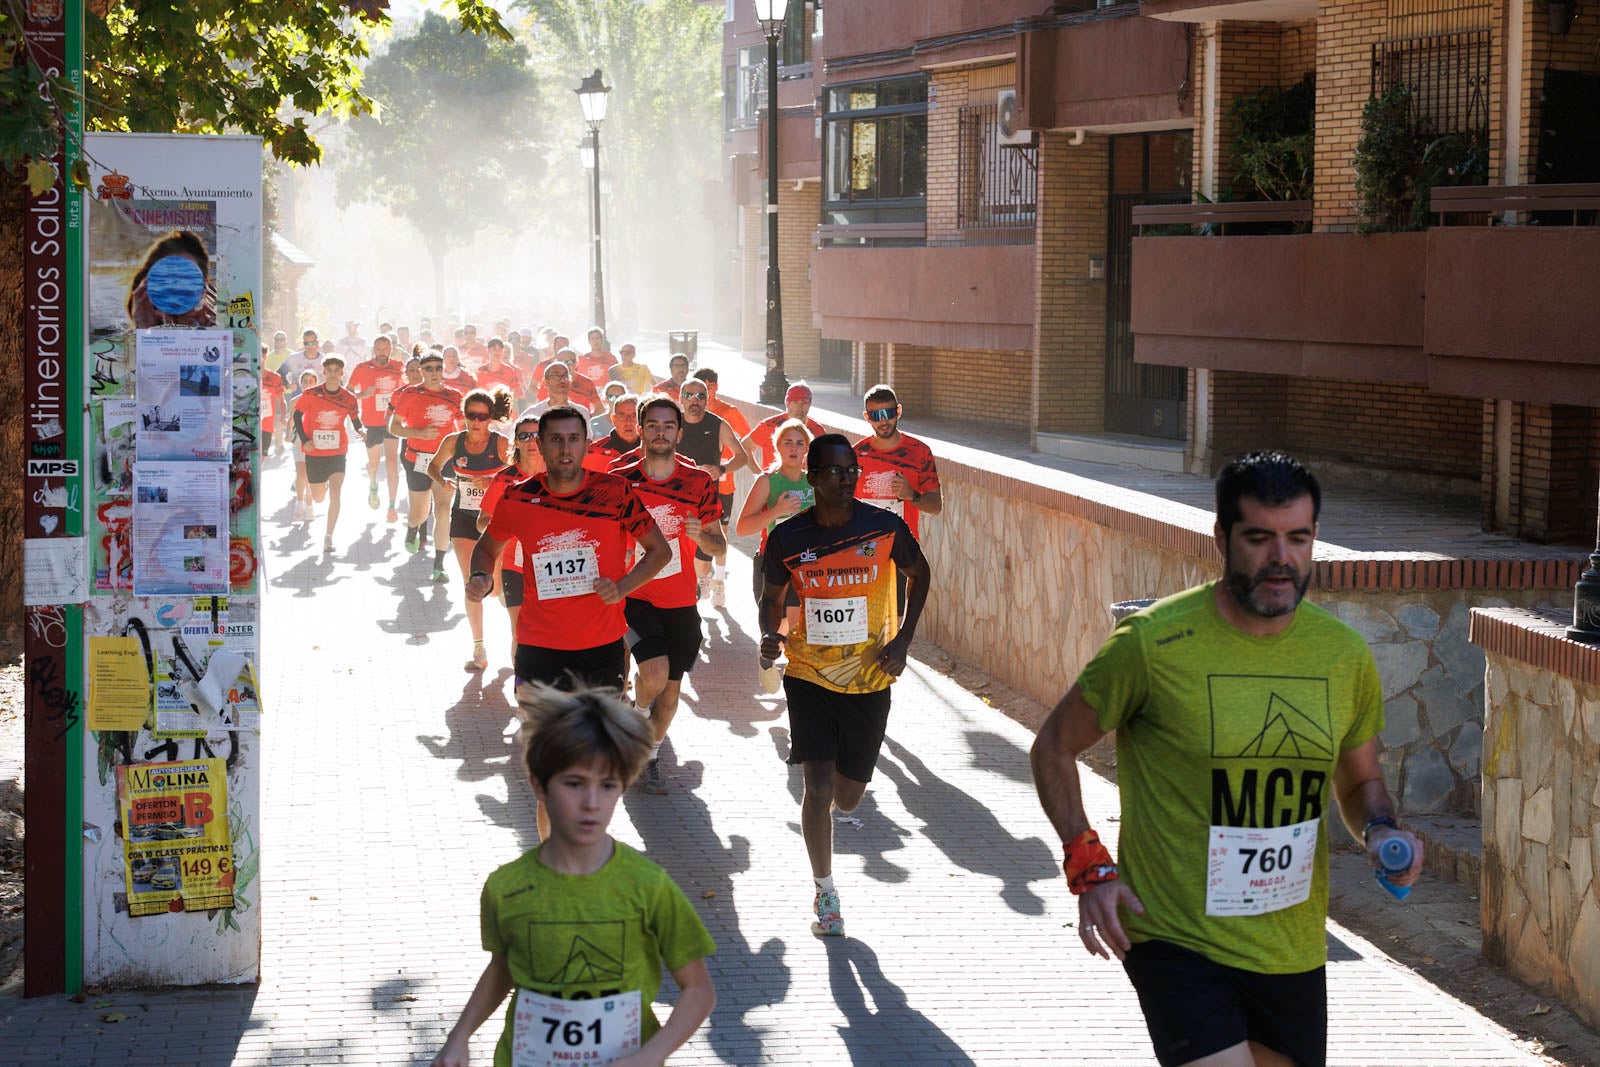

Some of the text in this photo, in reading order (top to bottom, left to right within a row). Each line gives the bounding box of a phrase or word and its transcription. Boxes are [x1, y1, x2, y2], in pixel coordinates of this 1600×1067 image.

[181, 186, 252, 200] Ayuntamiento
[69, 200, 79, 228] Ruta
[30, 267, 60, 428] tinerarios
[30, 463, 77, 474] MPS
[466, 487, 485, 497] 969
[544, 558, 586, 576] 1137
[806, 565, 869, 577] Club Deportivo
[814, 608, 855, 624] 1607
[184, 626, 209, 635] OFERTA
[225, 625, 253, 633] NTER
[151, 765, 208, 774] AUTOESCUELAS
[133, 769, 209, 789] MOLINA
[184, 792, 214, 825] B
[137, 811, 177, 820] PERMISO
[155, 848, 184, 856] CLASES
[182, 857, 230, 876] 149 €
[1238, 845, 1293, 875] 760
[1249, 877, 1273, 888] PABLO
[541, 1017, 603, 1047] 761
[553, 1051, 581, 1060] PABLO
